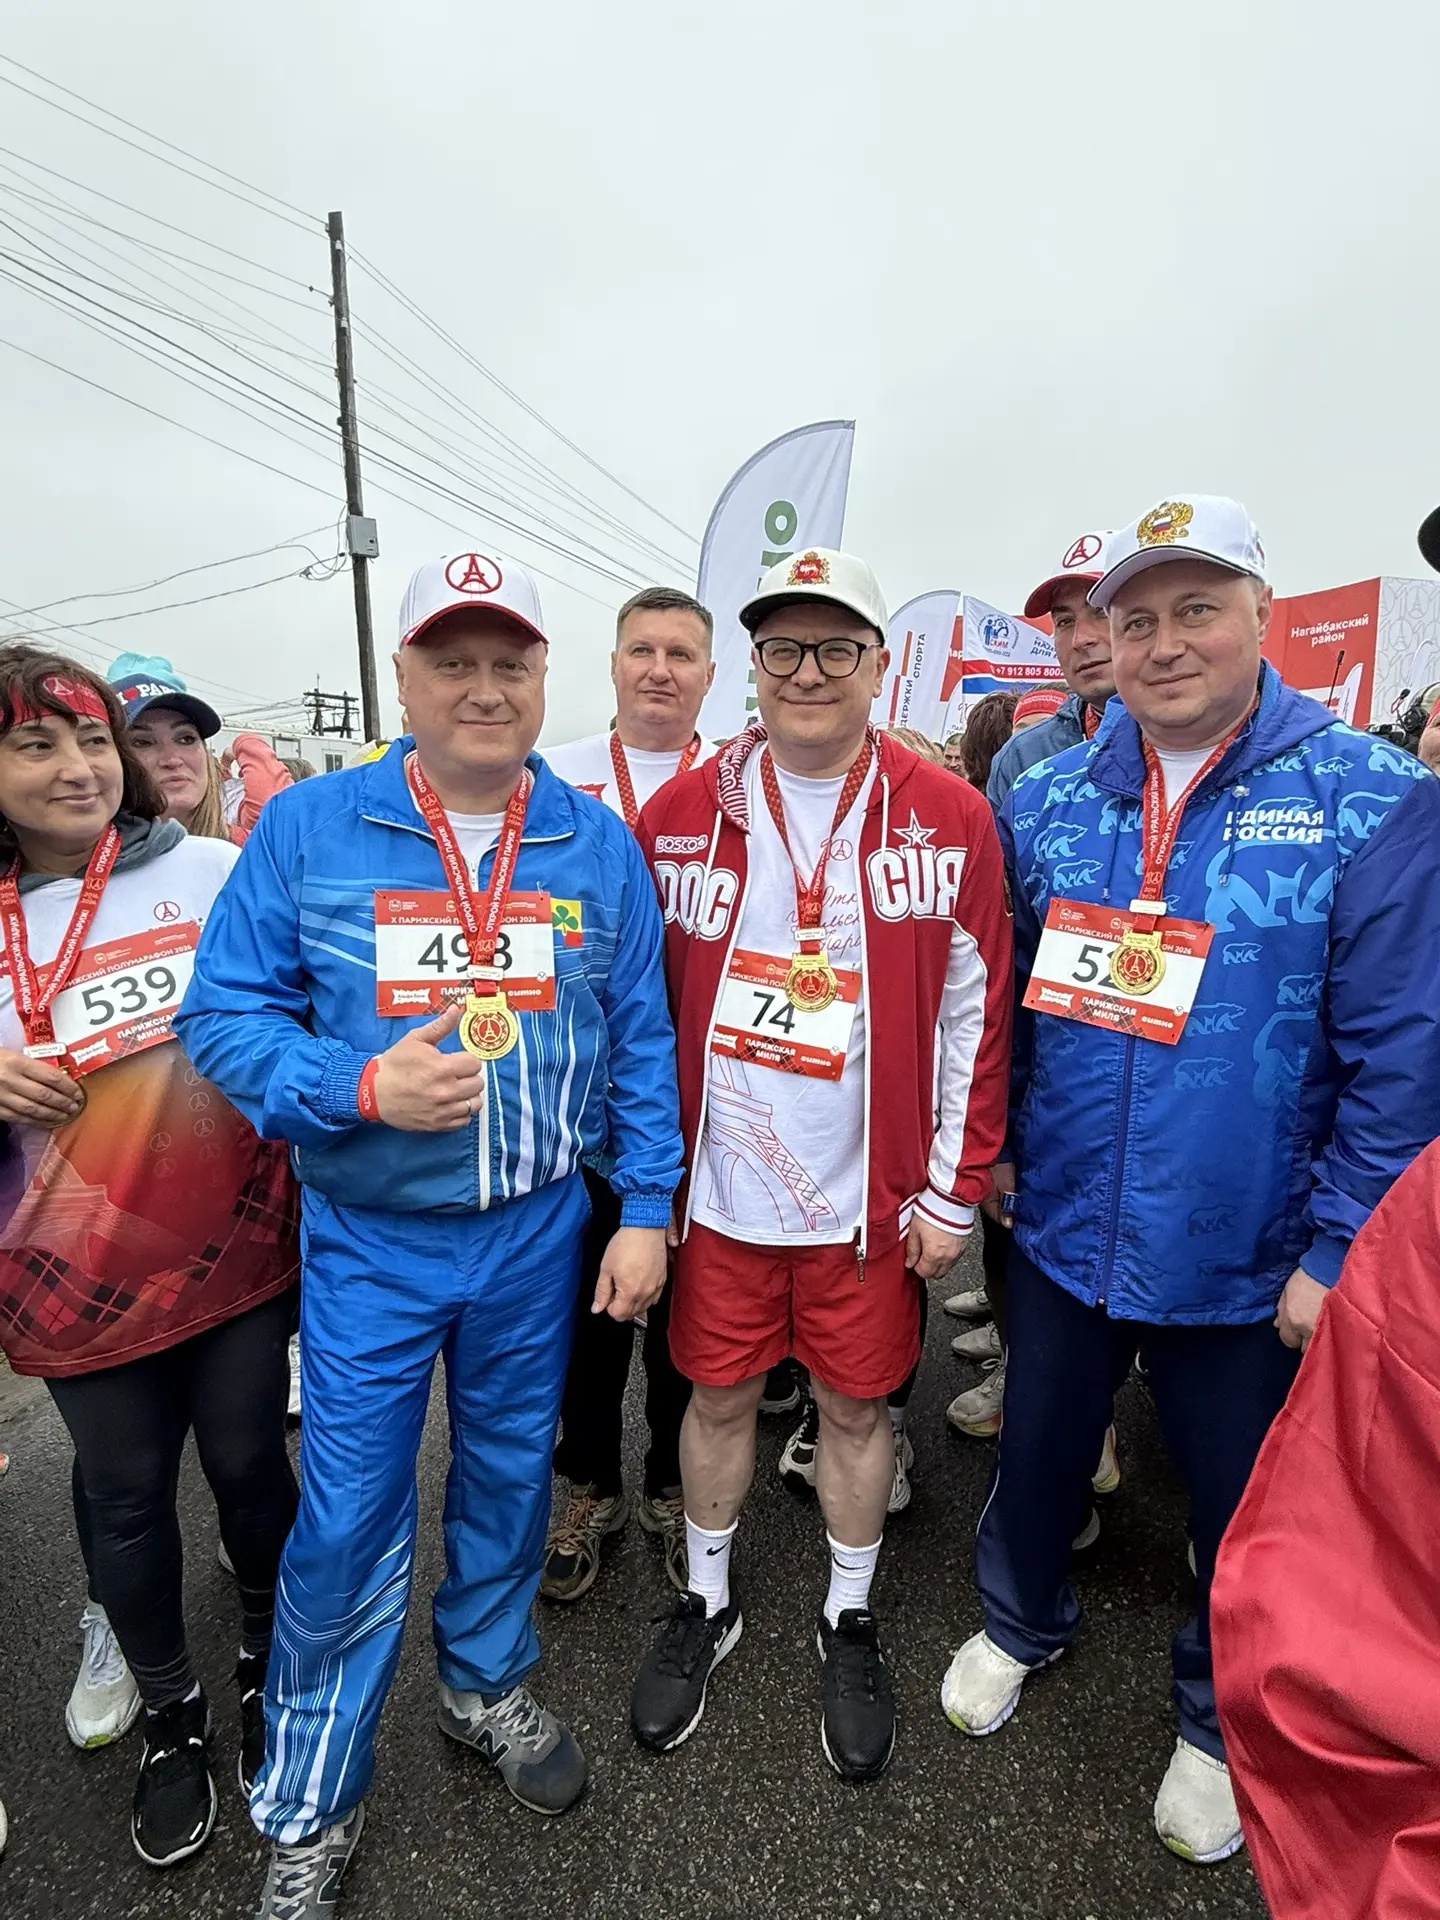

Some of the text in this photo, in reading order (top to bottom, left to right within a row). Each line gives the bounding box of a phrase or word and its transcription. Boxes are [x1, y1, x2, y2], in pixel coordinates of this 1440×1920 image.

[1291, 614, 1369, 638] Нагайбакский
[1311, 631, 1345, 648] район
[912, 633, 926, 679] СПОРТА
[1007, 667, 1023, 676] 912
[1025, 667, 1041, 676] 805
[399, 915, 452, 925] ПАРИЖСКИЙ
[519, 916, 537, 924] 2026
[460, 900, 478, 933] ОТКРОЙ
[486, 900, 500, 933] ОТКРОЙ
[1064, 924, 1113, 940] ПАРИЖСКИЙ
[1174, 945, 1192, 955] 2026
[107, 949, 174, 974] ПОЛУМАРАФОН
[175, 944, 193, 954] 2026
[81, 966, 177, 1026] 539
[507, 988, 542, 997] сытно
[751, 991, 796, 1035] 74
[1081, 996, 1138, 1016] ПАРИЖСКАЯ
[1092, 1009, 1120, 1022] МИЛЯ
[136, 1025, 168, 1042] МИЛЯ
[744, 1037, 796, 1056] ПАРИЖСКАЯ
[755, 1049, 781, 1062] МИЛЯ
